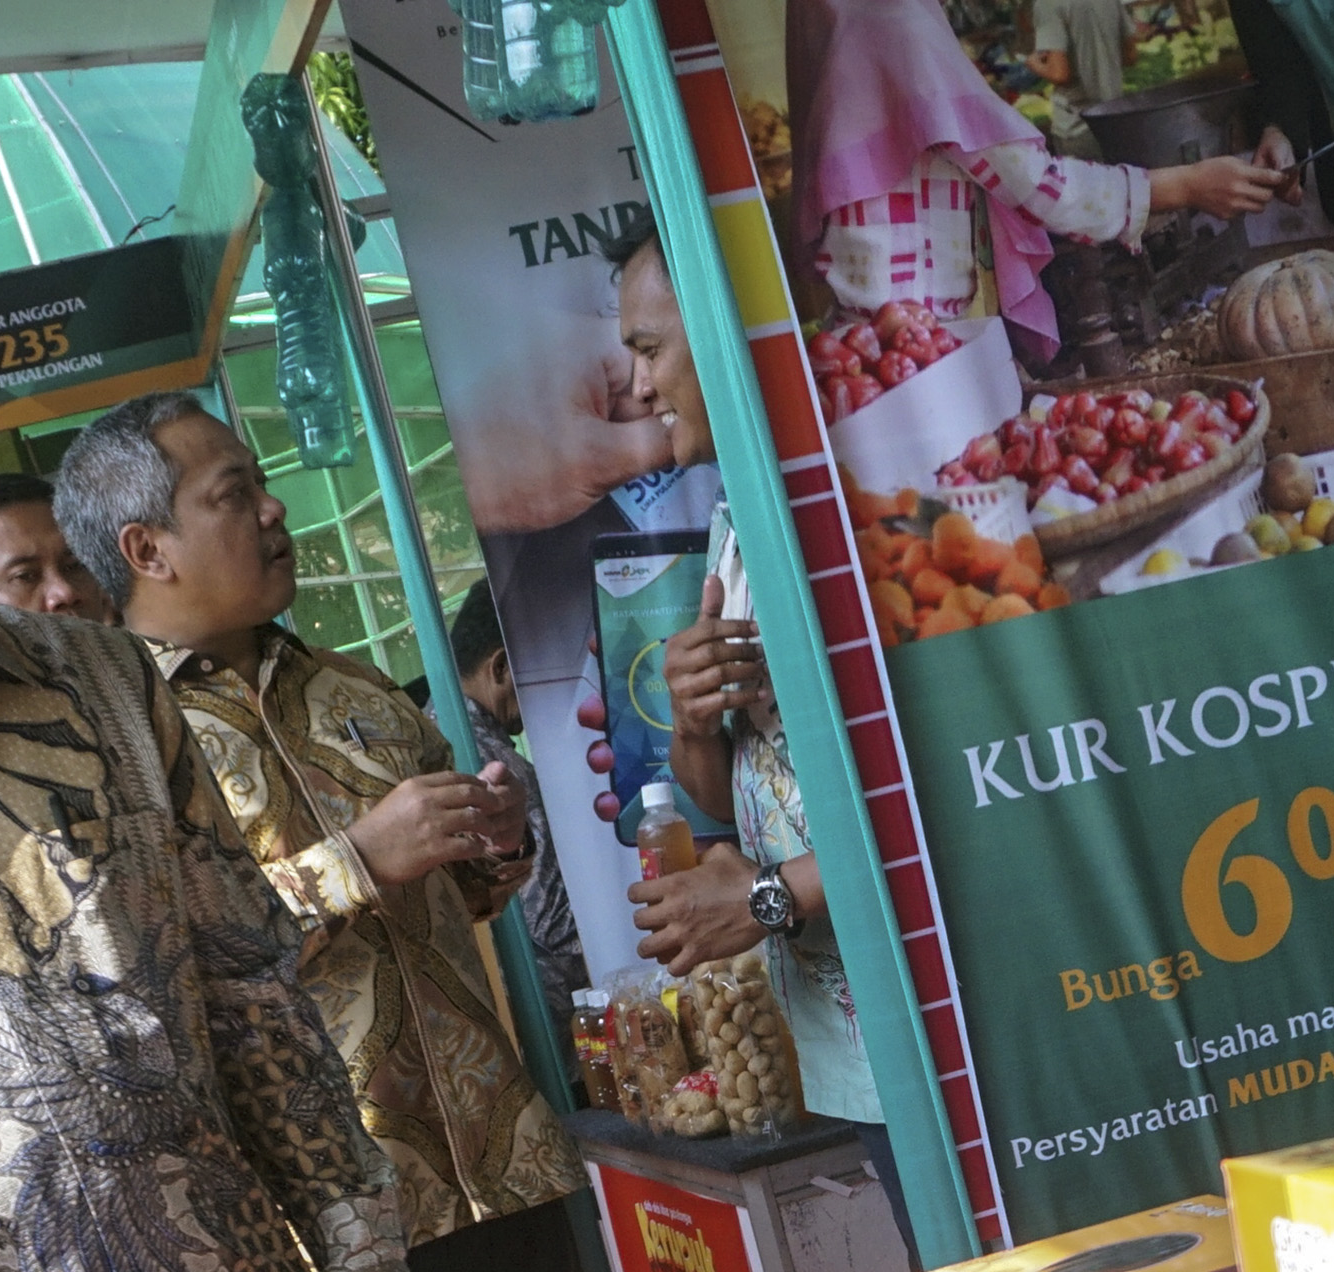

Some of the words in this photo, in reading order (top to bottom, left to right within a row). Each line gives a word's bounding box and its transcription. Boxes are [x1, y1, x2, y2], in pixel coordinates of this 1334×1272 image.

[618, 145, 641, 181] T
[9, 297, 87, 325] ANGGOTA
[962, 718, 1128, 808] KUR
[1058, 949, 1203, 1012] Bunga
[1174, 1021, 1279, 1069] Usaha
[1009, 1092, 1219, 1170] Persyaratan
